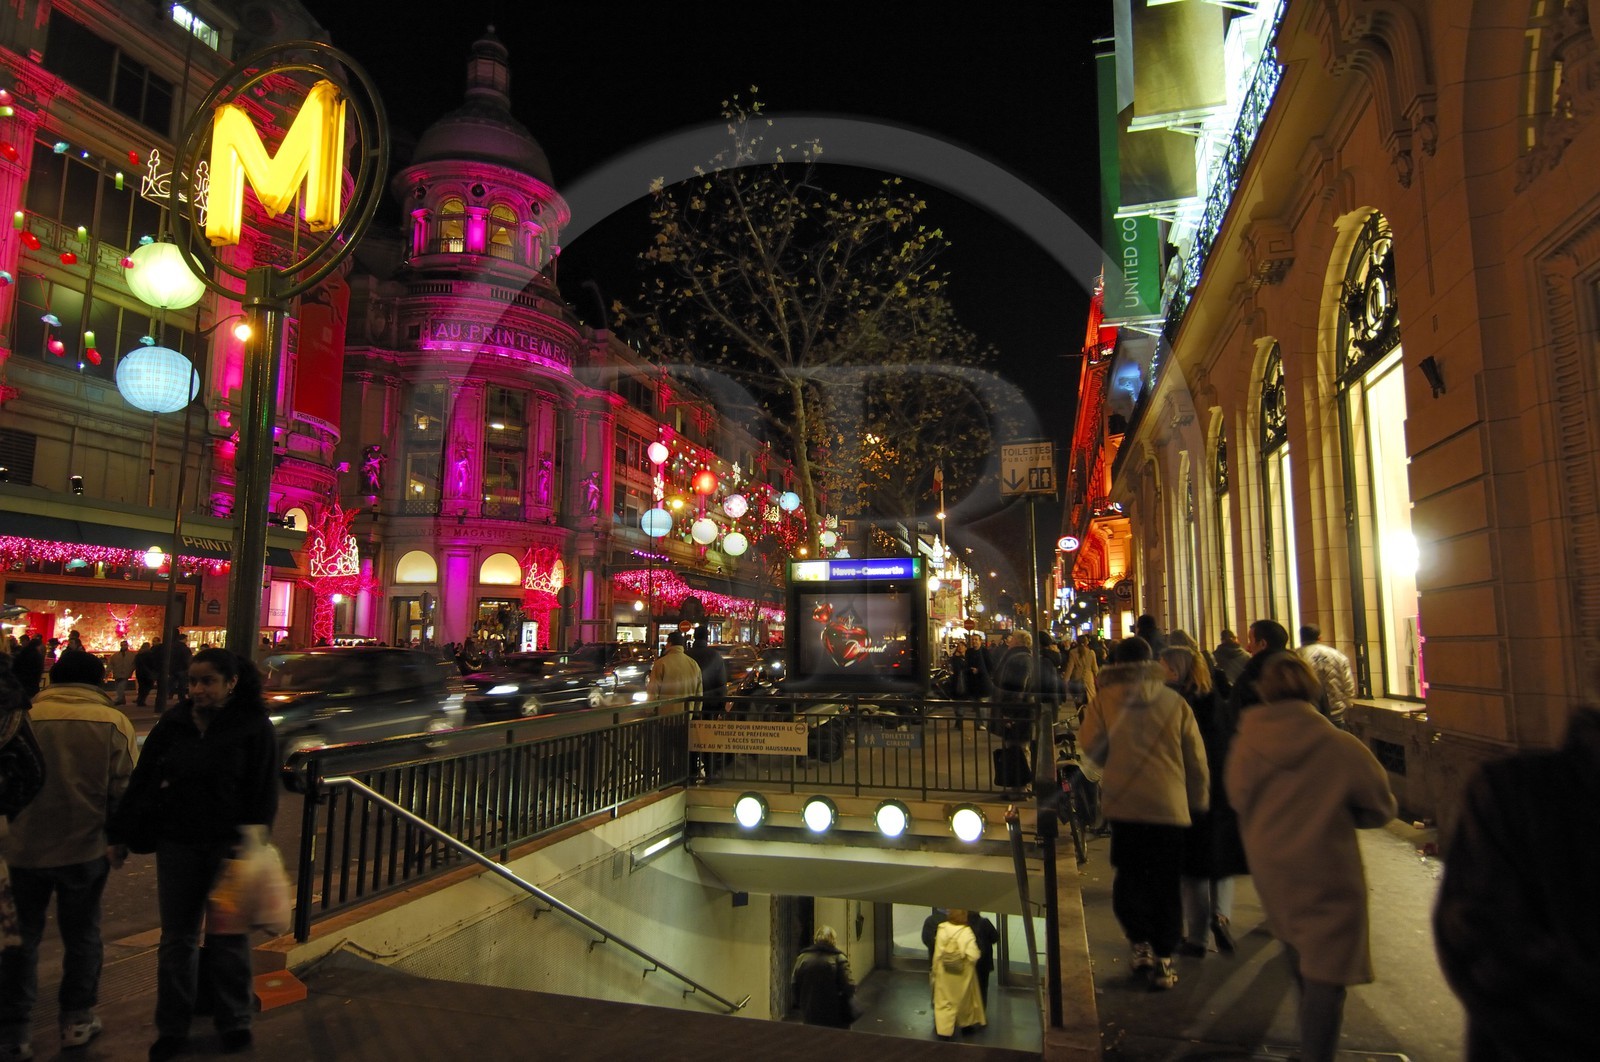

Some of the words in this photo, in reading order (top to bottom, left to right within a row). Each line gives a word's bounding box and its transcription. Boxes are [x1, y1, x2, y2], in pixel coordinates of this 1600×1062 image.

[206, 79, 347, 247] M
[1124, 247, 1139, 308] UNITED
[435, 323, 461, 338] AU
[469, 325, 567, 363] PRINTEMPS
[1003, 446, 1051, 457] TOILETTES
